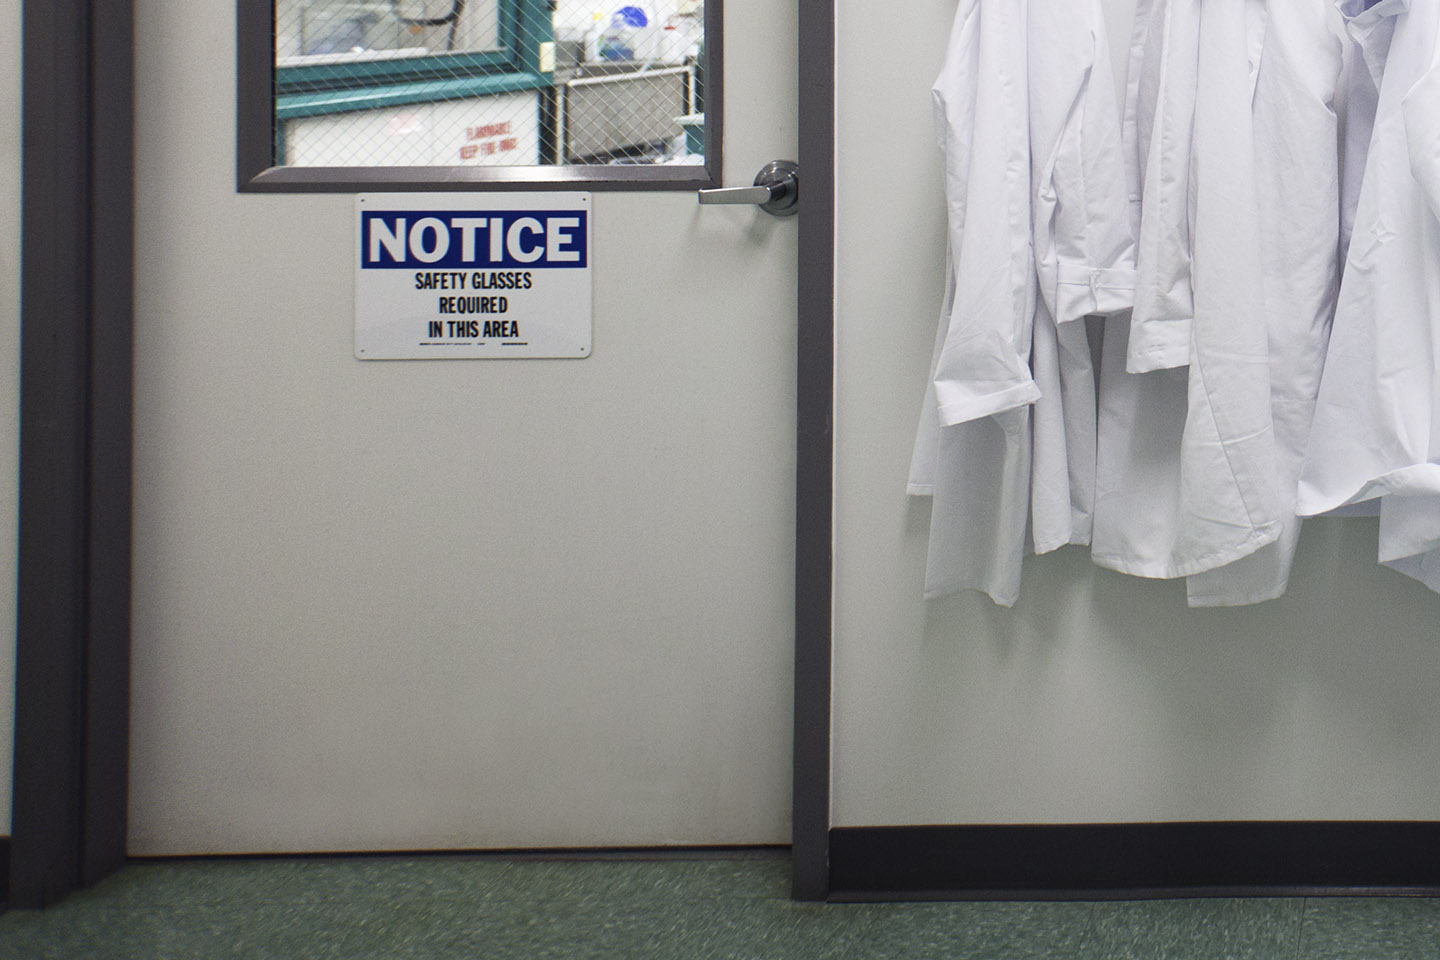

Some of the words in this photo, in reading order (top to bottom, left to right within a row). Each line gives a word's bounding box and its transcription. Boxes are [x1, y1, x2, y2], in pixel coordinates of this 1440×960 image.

[369, 217, 580, 263] NOTICE
[415, 272, 467, 290] SAFETY
[472, 272, 532, 290] GLASSES
[439, 296, 508, 314] REQUIRED
[428, 320, 443, 338] IN
[447, 320, 479, 338] THIS
[483, 320, 519, 338] AREA
